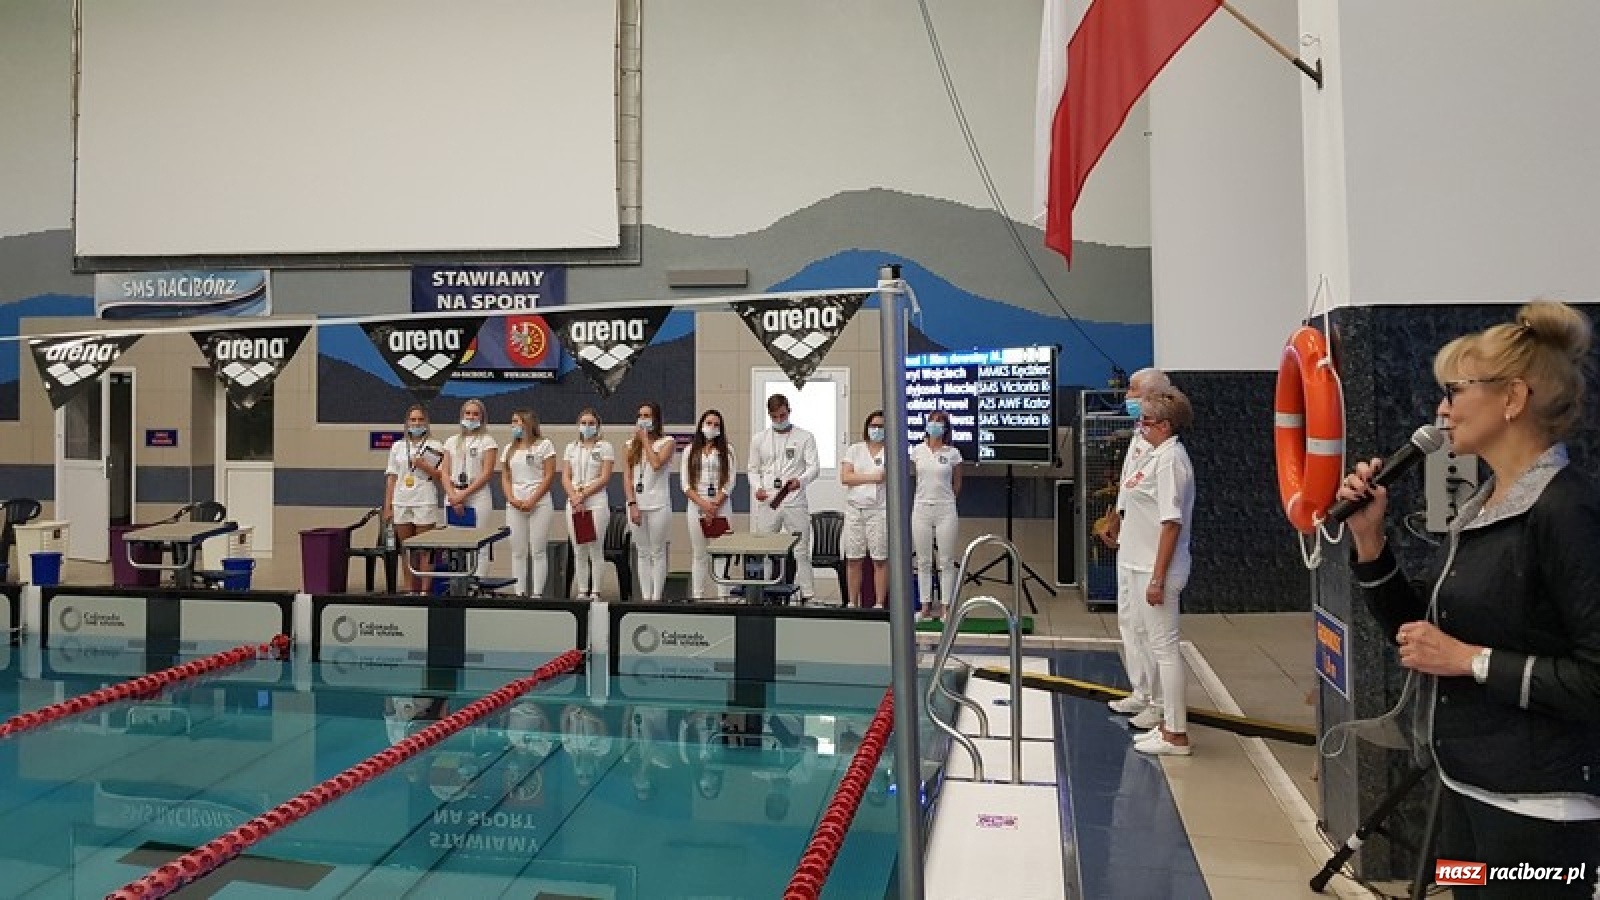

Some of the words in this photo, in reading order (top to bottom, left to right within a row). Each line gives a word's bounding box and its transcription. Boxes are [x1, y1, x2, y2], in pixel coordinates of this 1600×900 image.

[121, 279, 155, 297] SMS
[157, 274, 238, 297] RACIBÓRZ
[432, 271, 544, 287] STAWIAMY
[437, 293, 467, 309] NA
[471, 293, 541, 309] SPORT
[763, 307, 837, 331] arena
[388, 328, 461, 353] arena
[570, 319, 645, 344] arena
[45, 342, 113, 362] arena
[215, 337, 285, 360] arena
[359, 621, 399, 630] Colorado
[661, 629, 705, 639] Colorado
